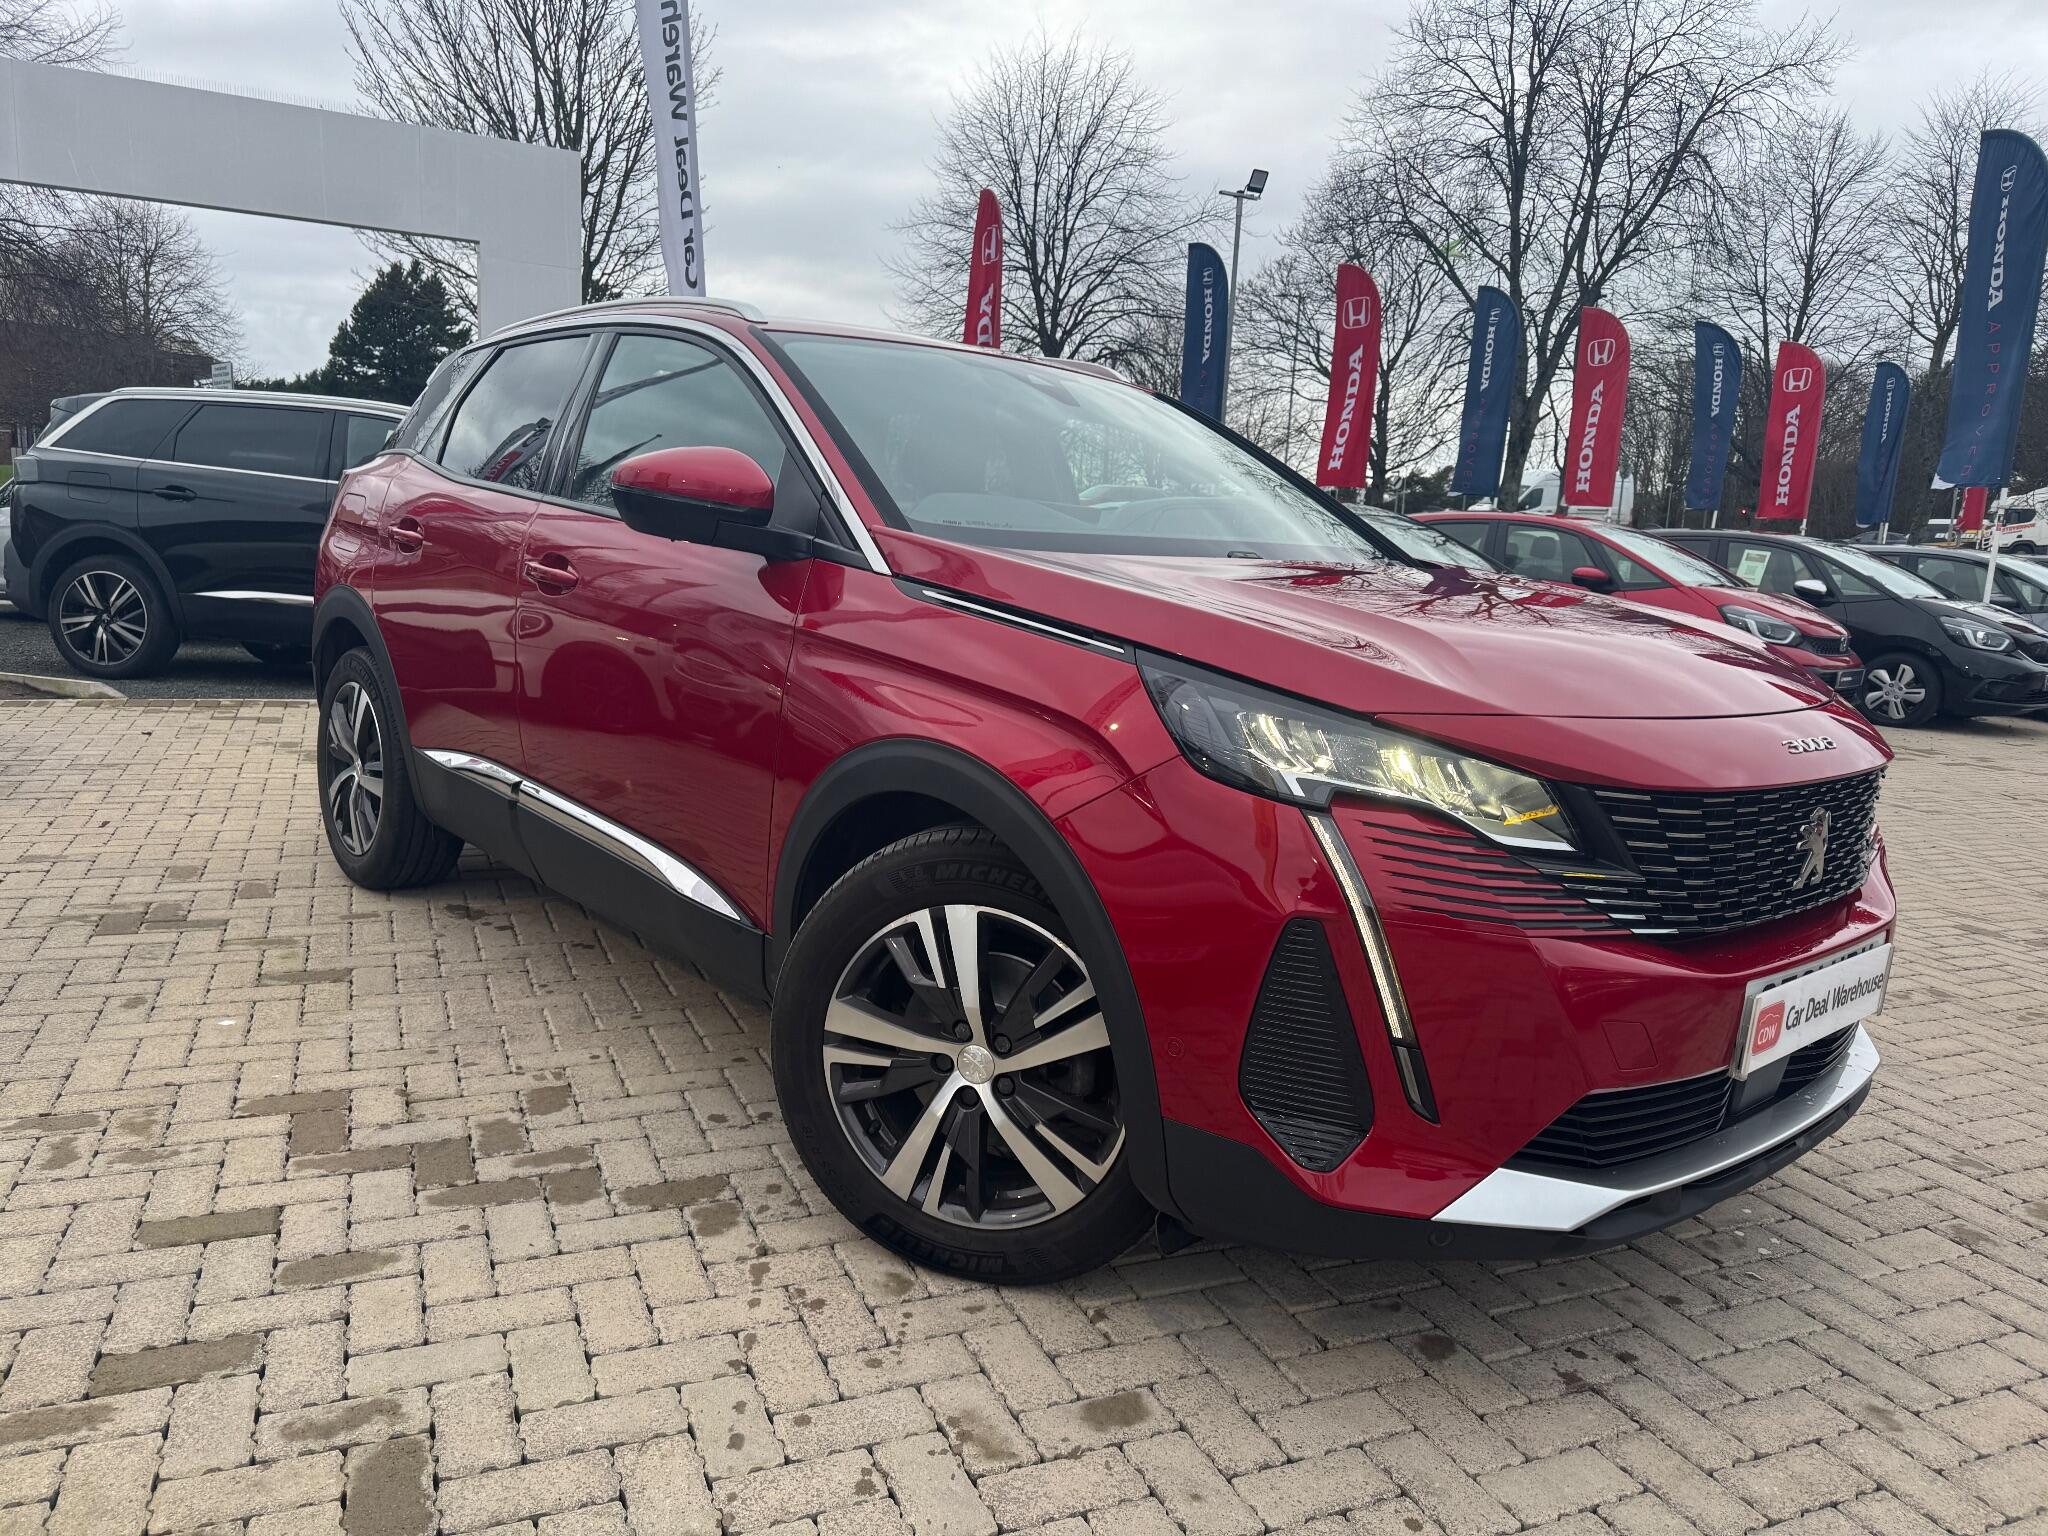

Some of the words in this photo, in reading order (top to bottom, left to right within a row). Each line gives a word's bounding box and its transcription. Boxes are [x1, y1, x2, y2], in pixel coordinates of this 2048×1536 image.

[1988, 194, 2010, 312] HONDA
[1202, 287, 1213, 364] HONDA
[1480, 325, 1496, 392] HONDA
[1328, 344, 1363, 471] HONDA
[1711, 358, 1724, 418] HONDA
[1881, 390, 1893, 444] HONDA
[1960, 321, 2001, 476] APPROVED
[1576, 380, 1604, 493] HONDA
[1776, 404, 1801, 506] HONDA
[1781, 736, 1837, 754] 3008
[1758, 1023, 1778, 1045] CDW
[1786, 1005, 1804, 1030] Car
[1805, 990, 1831, 1023] Deal
[1832, 973, 1884, 1010] Warehouse
